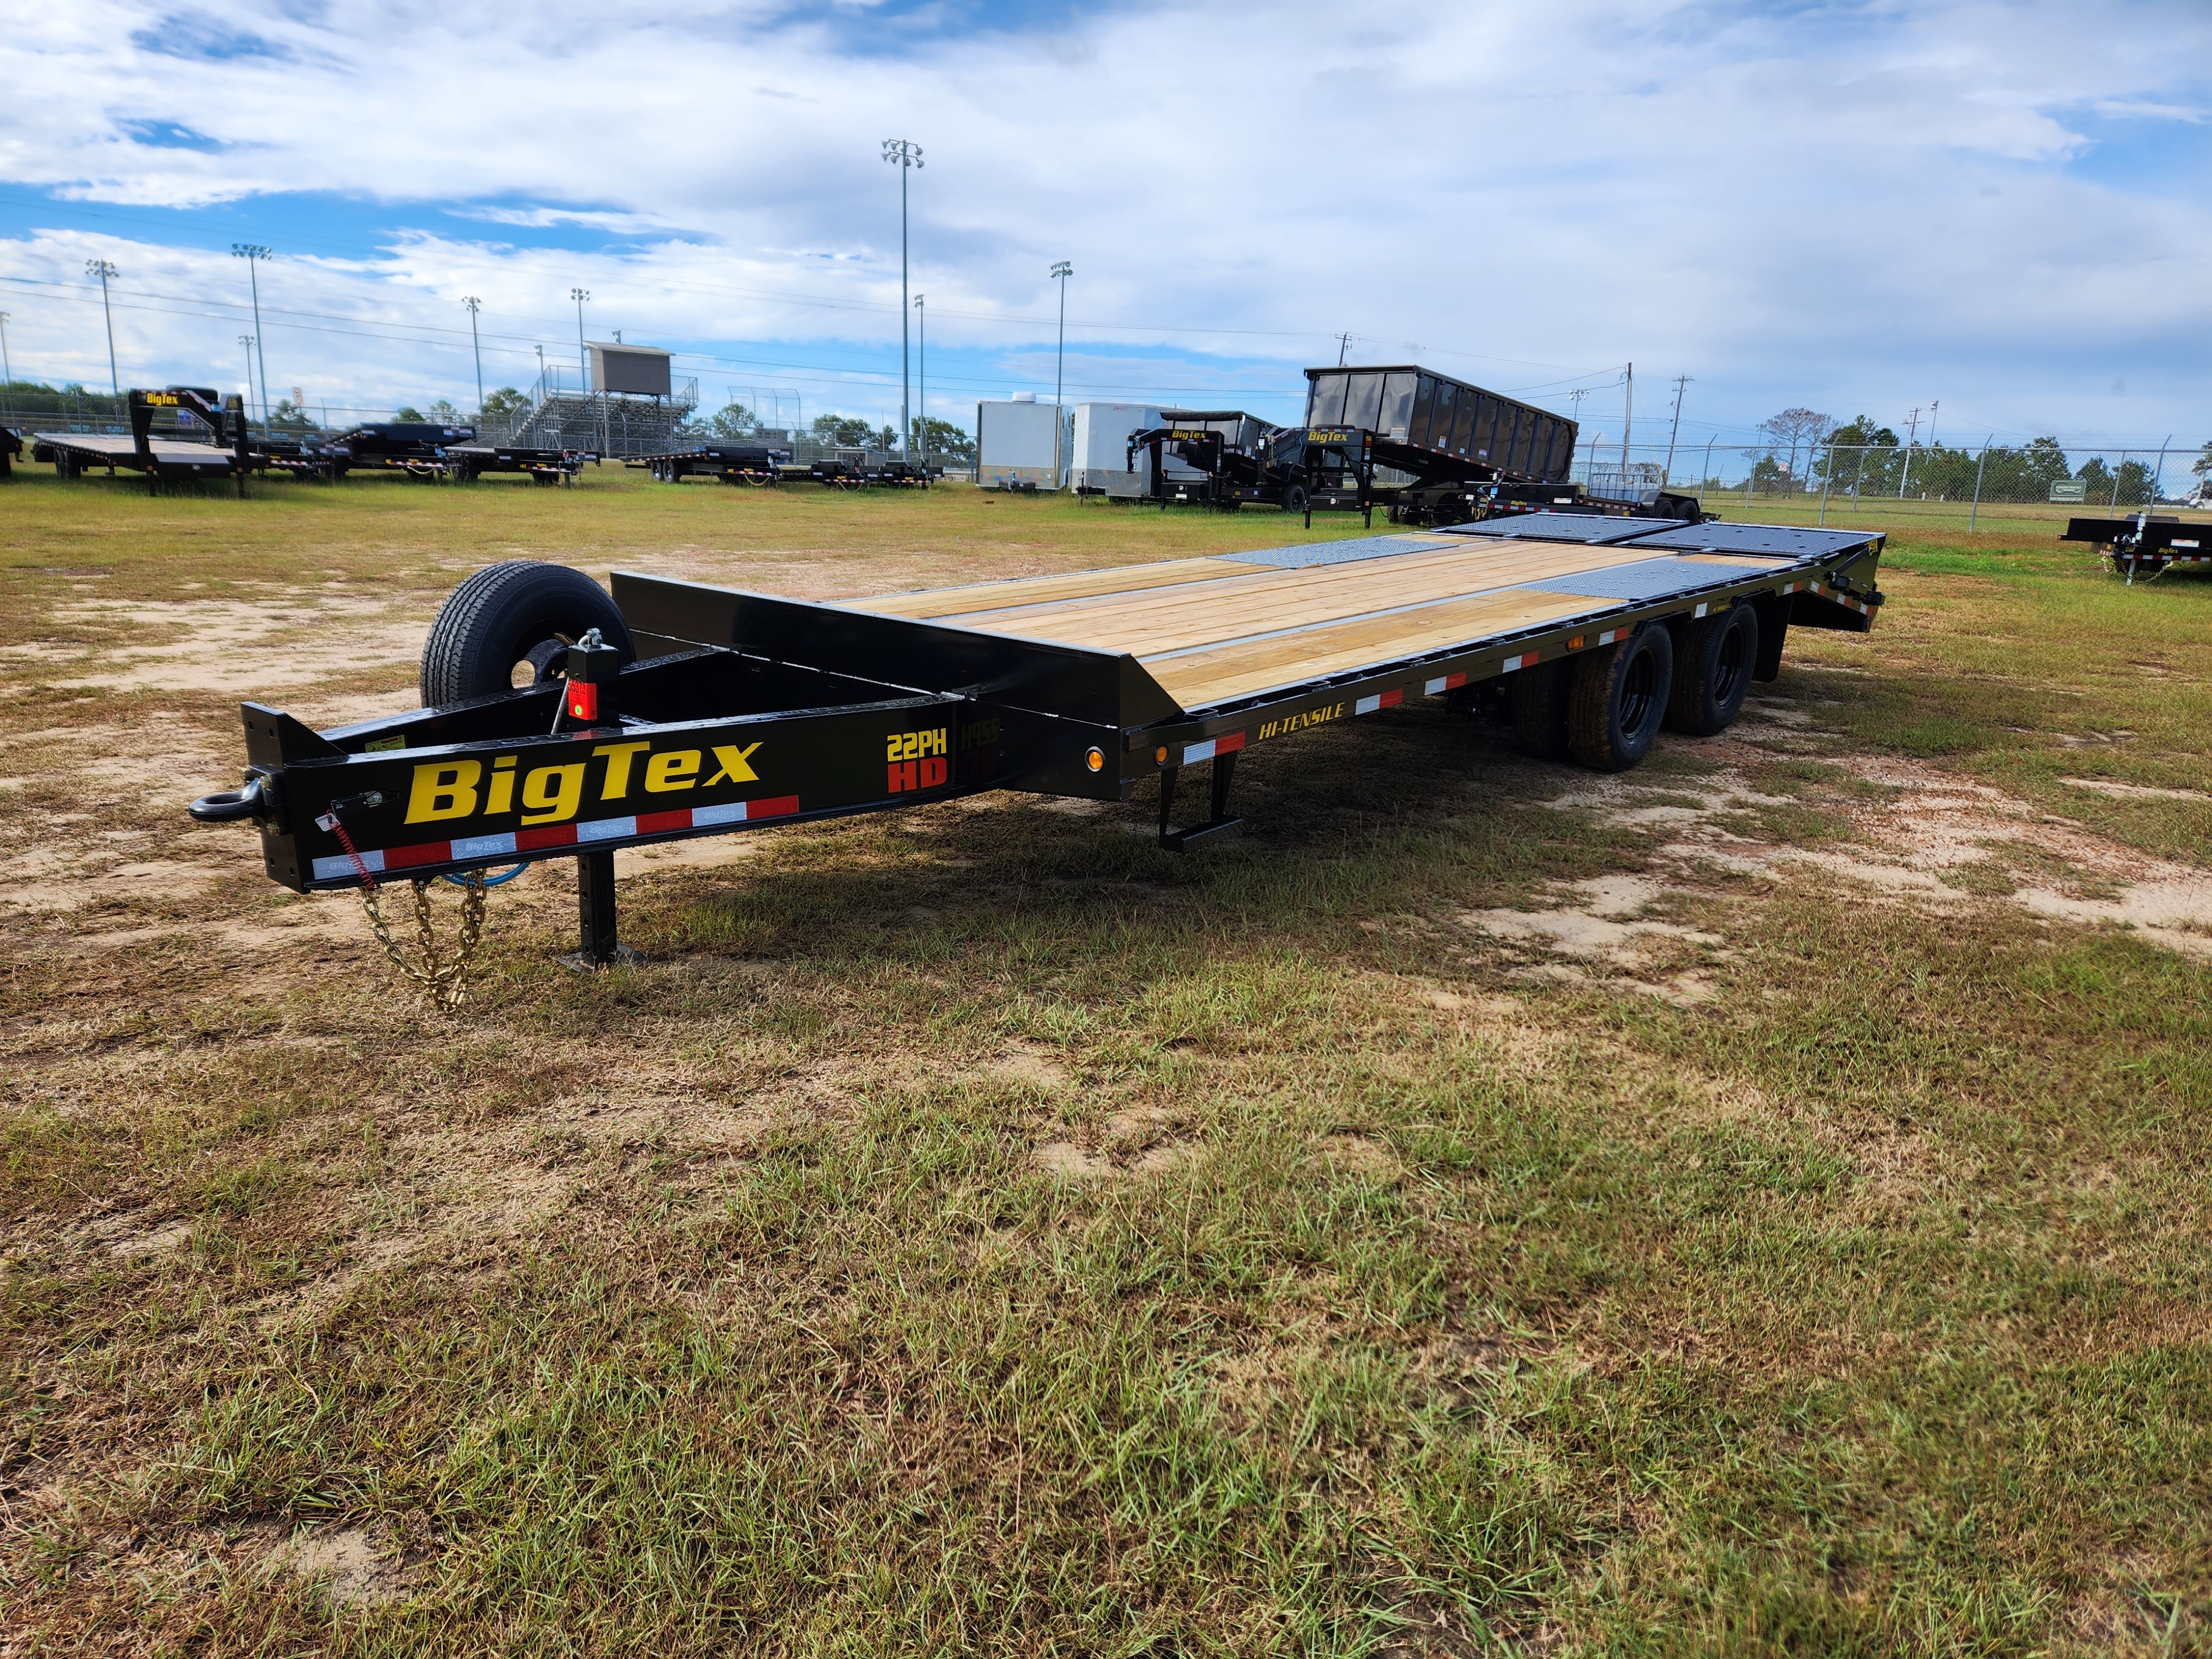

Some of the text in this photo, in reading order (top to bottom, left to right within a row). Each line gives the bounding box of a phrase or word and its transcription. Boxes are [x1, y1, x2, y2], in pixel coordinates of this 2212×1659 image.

[147, 393, 178, 406] BigTex
[1172, 430, 1207, 440] BigTex
[1308, 431, 1348, 443] BigTex
[1259, 702, 1345, 740] HI-TENSILE
[887, 728, 947, 761] 22PH
[404, 741, 764, 826] BigTex
[888, 757, 947, 794] HD
[466, 841, 502, 851] BigTex
